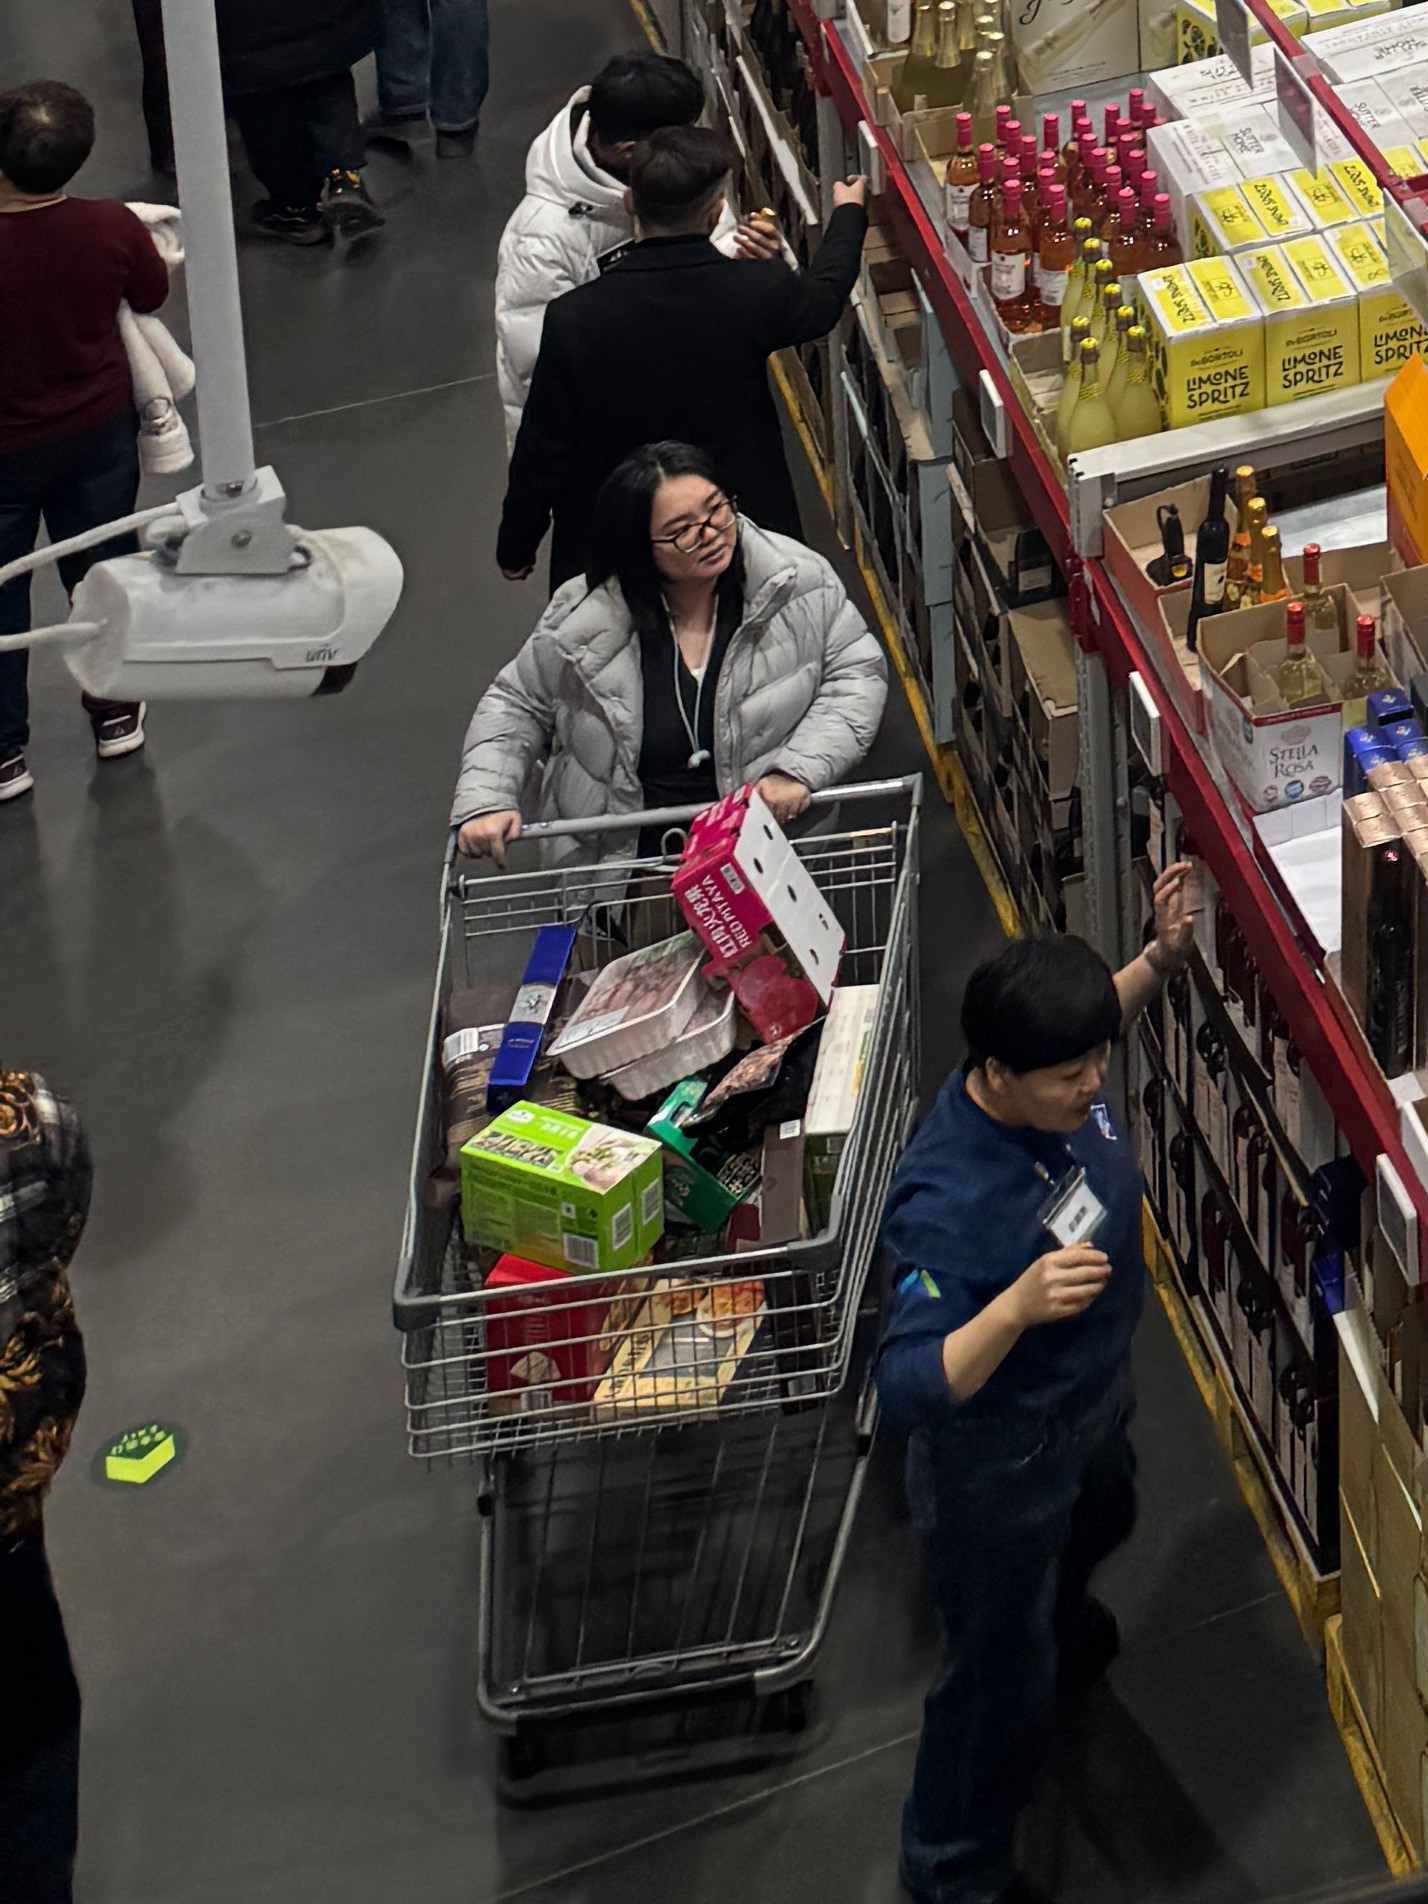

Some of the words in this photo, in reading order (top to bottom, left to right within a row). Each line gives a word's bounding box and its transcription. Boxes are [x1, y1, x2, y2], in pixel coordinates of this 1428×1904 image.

[1282, 344, 1344, 373] LIMONE
[1186, 364, 1249, 393] LIMONE
[1282, 361, 1345, 390] SPRITZ
[1186, 382, 1251, 410] SPRITZ
[1269, 744, 1319, 765] STELLA
[1274, 759, 1314, 779] ROSA
[684, 883, 739, 959] 红肉火龙果
